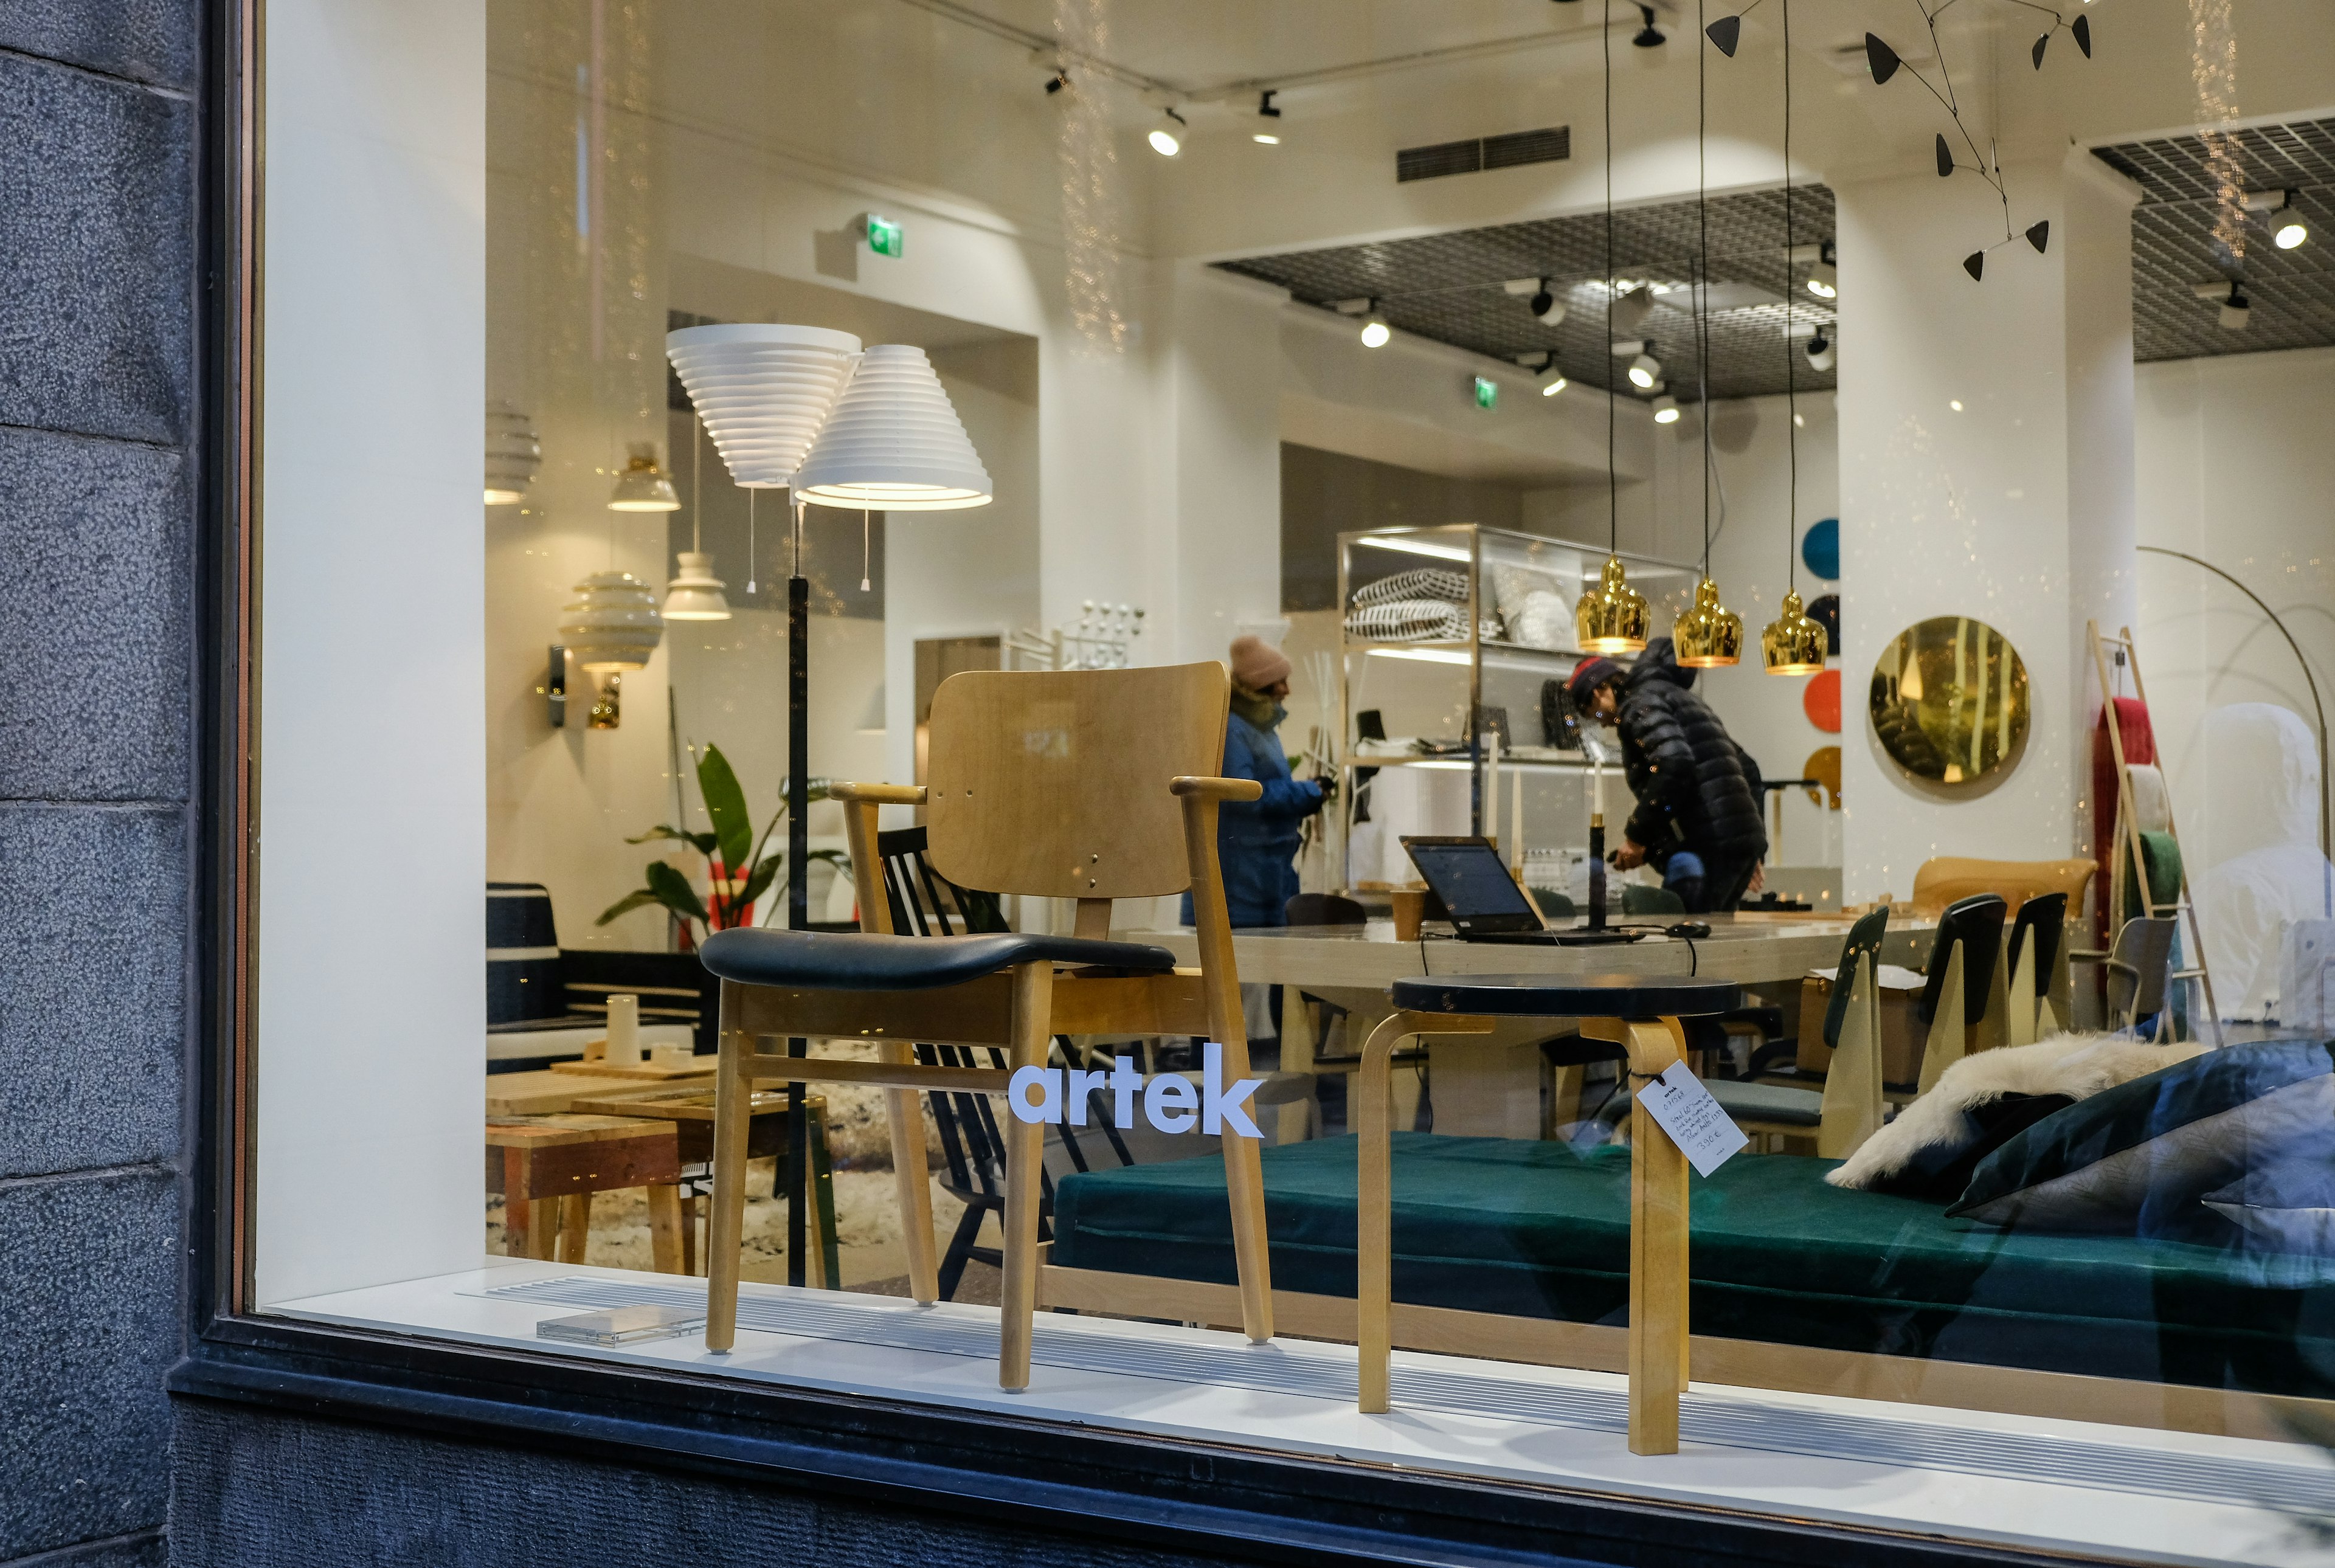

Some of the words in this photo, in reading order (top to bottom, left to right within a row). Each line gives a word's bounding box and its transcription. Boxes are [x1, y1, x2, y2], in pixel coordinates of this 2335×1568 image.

[1008, 1042, 1265, 1139] artek
[1664, 1086, 1678, 1097] artek
[1699, 1119, 1712, 1131] Aalto
